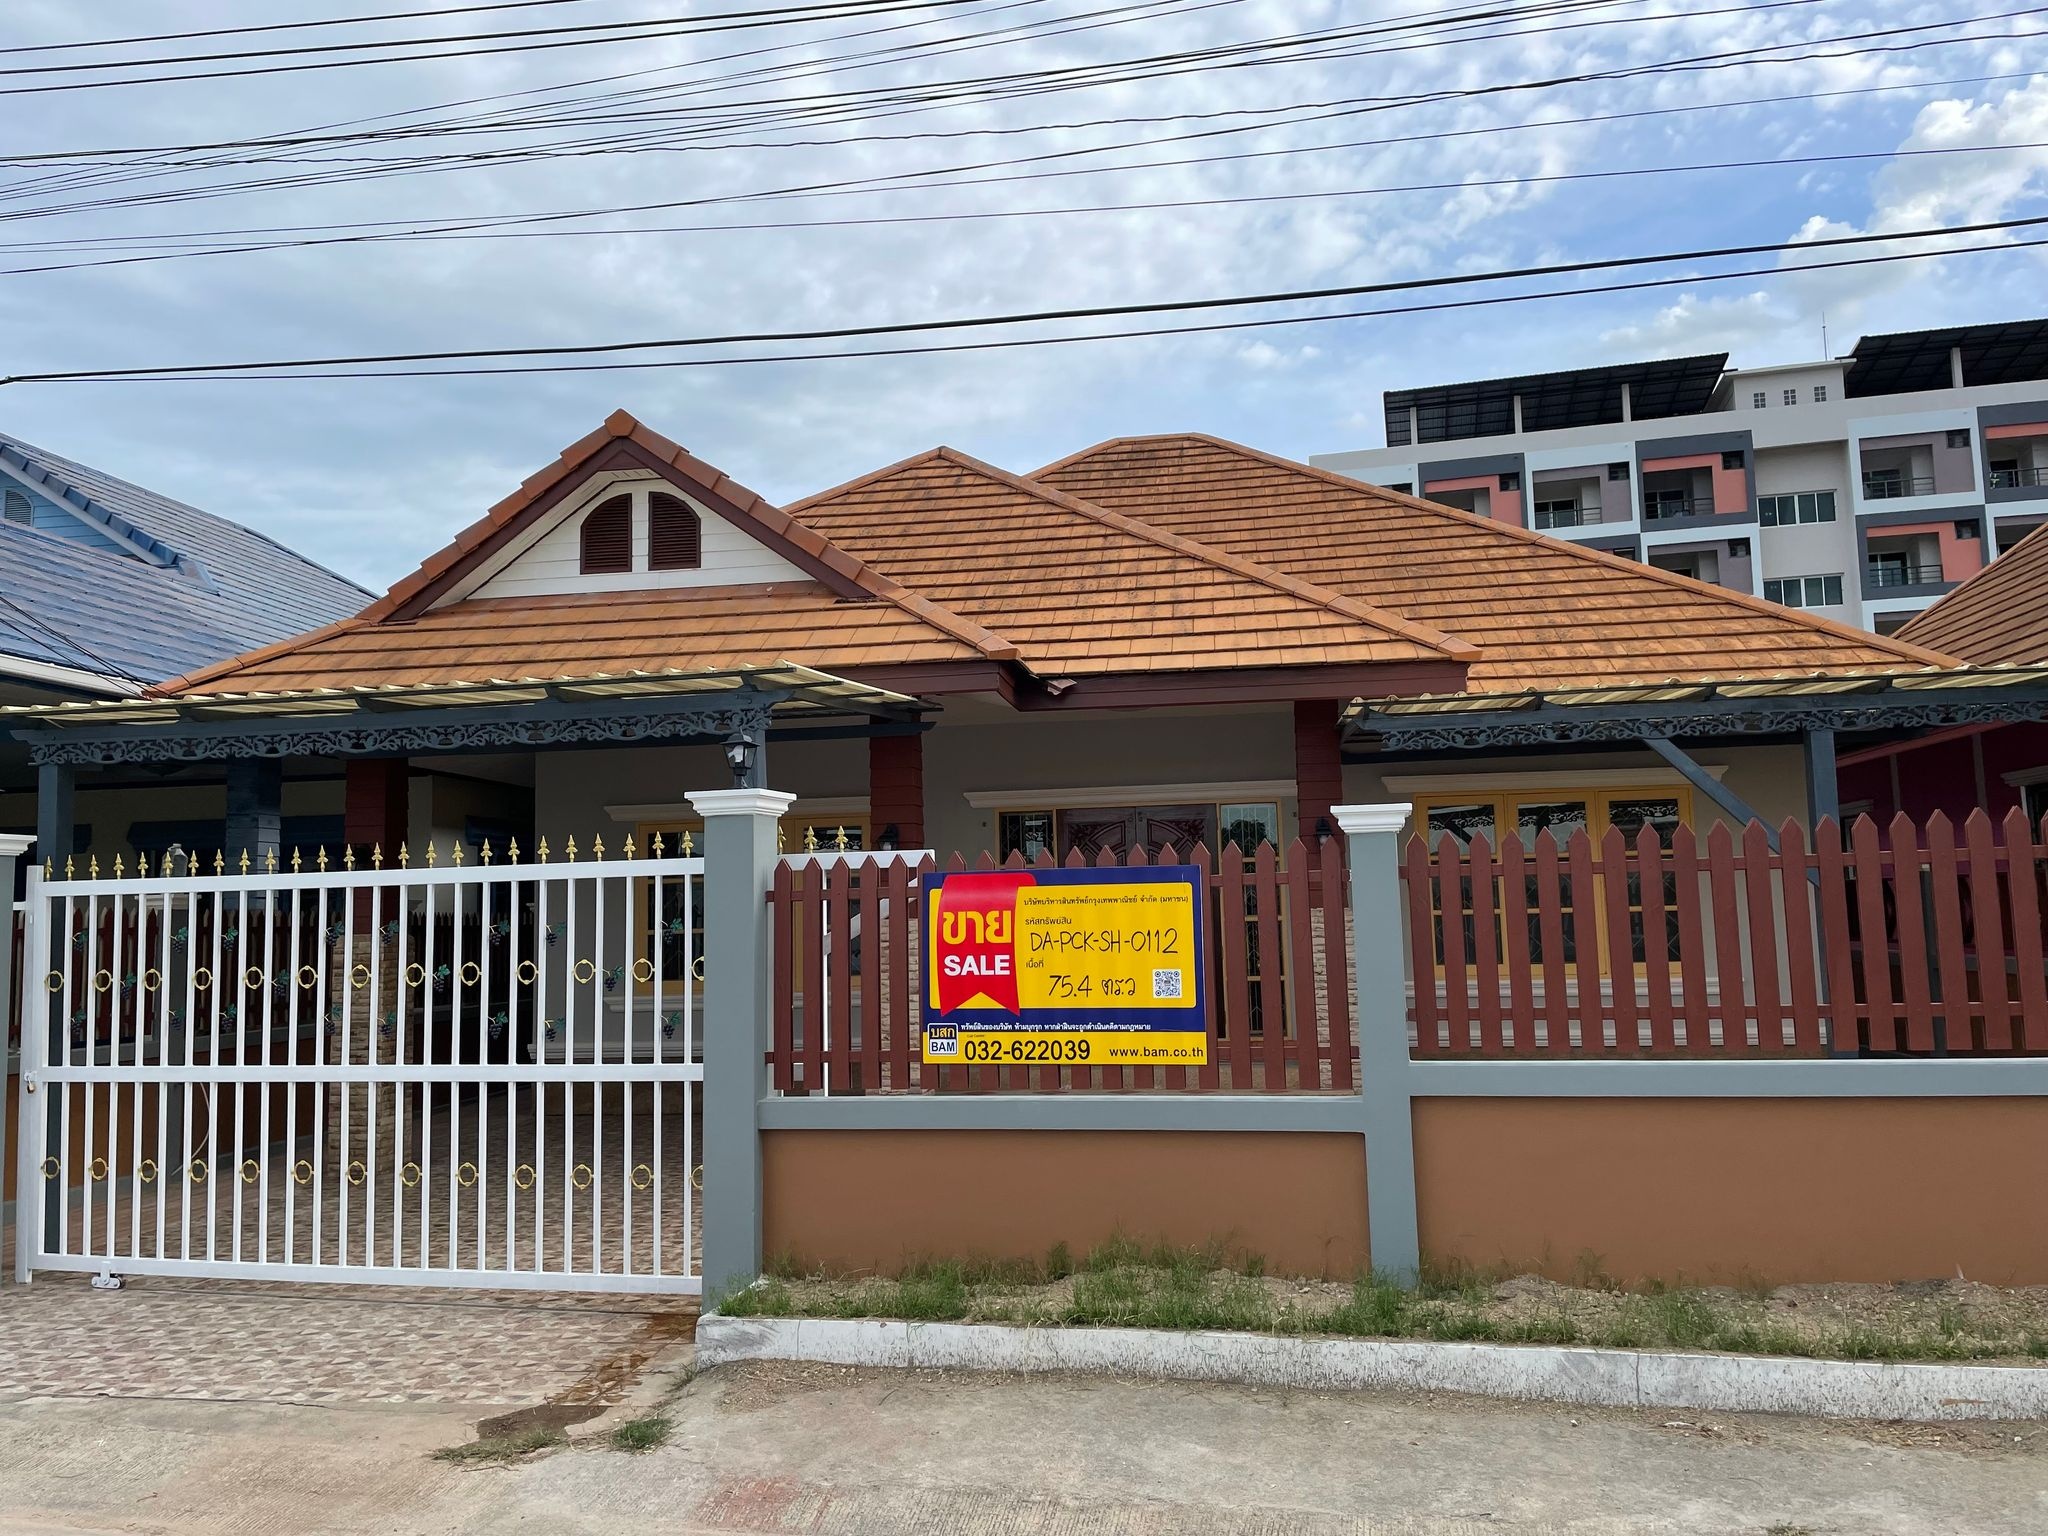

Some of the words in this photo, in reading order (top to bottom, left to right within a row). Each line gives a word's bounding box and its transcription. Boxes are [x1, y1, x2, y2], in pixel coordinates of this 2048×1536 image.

[1160, 896, 1189, 904] (มหาชน)
[1025, 916, 1072, 926] รหัสทรัพย์สิน
[942, 910, 1012, 945] ขาย
[1030, 928, 1178, 953] DA-PCK-SH-0112
[944, 954, 1011, 976] SALE
[1025, 958, 1044, 968] เนื้อที่
[1048, 975, 1092, 997] 75.4
[931, 1027, 955, 1038] บสก
[931, 1041, 955, 1052] BAM
[964, 1039, 1090, 1061] 032-622039
[1109, 1047, 1203, 1057] www.bam.co.th
